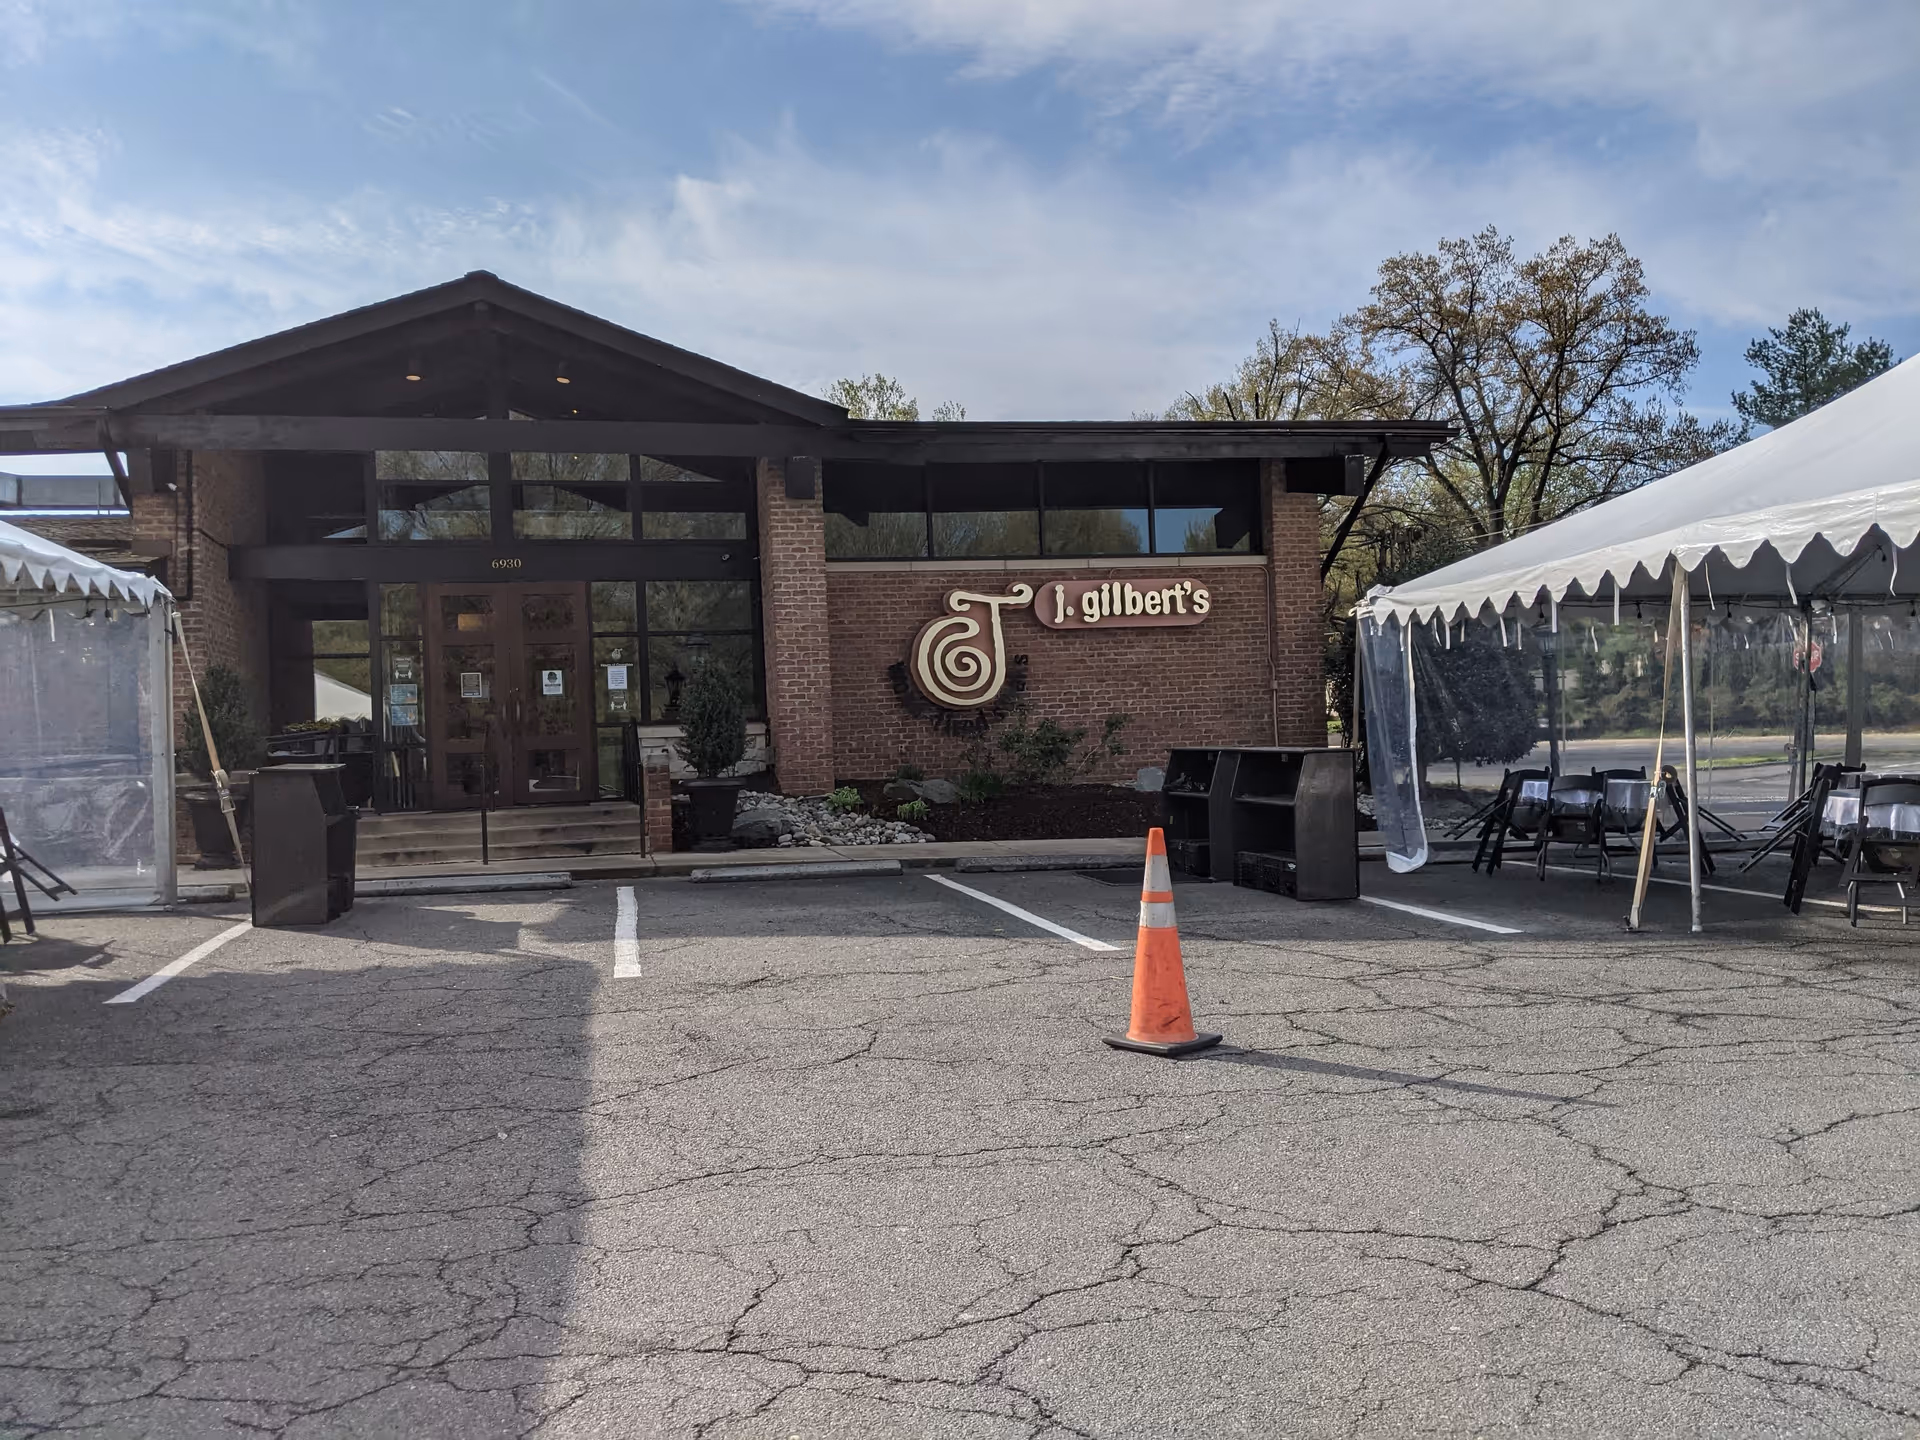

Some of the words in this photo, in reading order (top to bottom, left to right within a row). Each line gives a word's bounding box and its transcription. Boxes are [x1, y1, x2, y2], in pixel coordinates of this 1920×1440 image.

[491, 558, 522, 569] 6930
[1054, 584, 1075, 624] j.
[1082, 580, 1210, 623] gilbert's
